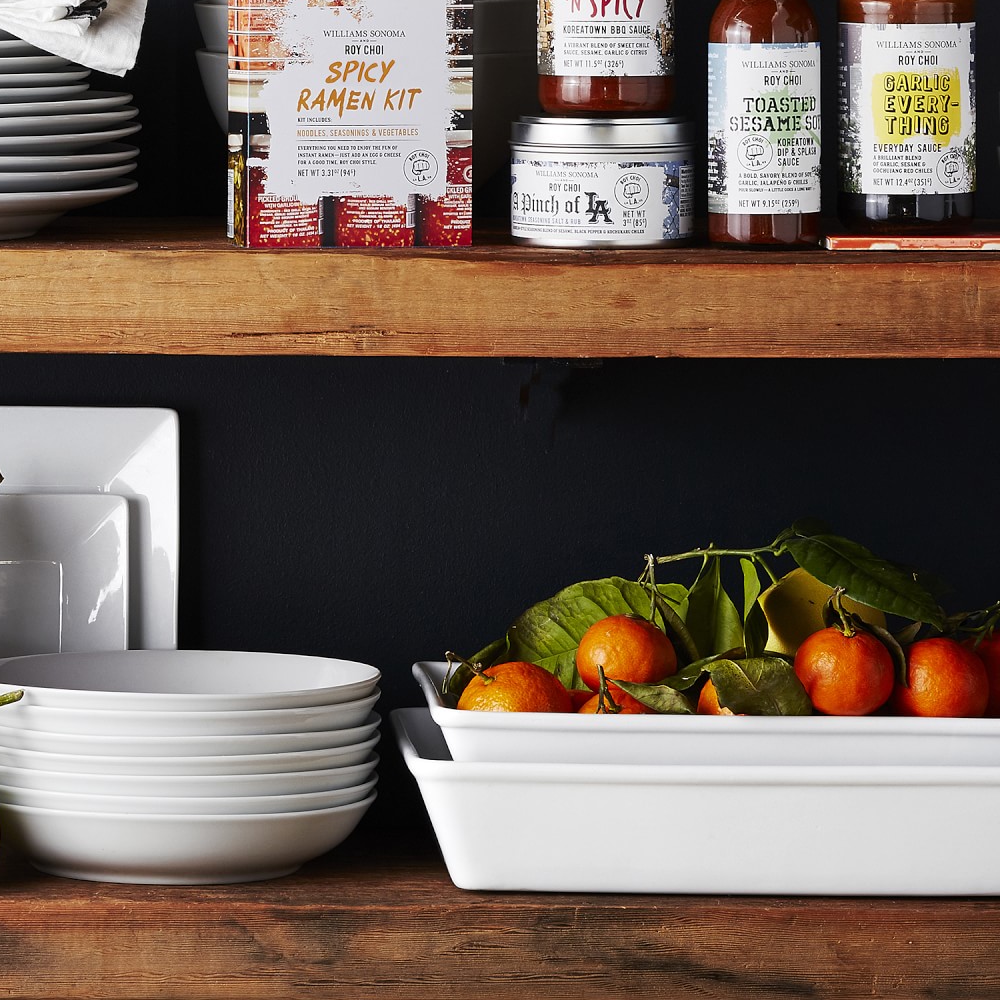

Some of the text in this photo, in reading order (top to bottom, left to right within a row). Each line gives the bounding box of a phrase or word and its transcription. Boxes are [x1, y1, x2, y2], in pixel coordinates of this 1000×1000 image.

[323, 30, 406, 38] WILLIAMS SONOMA
[563, 25, 651, 34] KOREATOWN BBQ SAUCE
[876, 40, 958, 49] WILLIAMS SONOMA
[344, 44, 384, 55] ROY CHOI
[564, 60, 573, 68] NET
[574, 60, 583, 68] WT
[742, 60, 816, 68] WILLIAMS SONOMA
[898, 55, 938, 66] ROY CHOI
[325, 59, 396, 84] SPICY
[764, 76, 802, 86] ROY CHOI
[884, 74, 950, 92] GARLIC
[297, 87, 422, 120] RAMEN KIT
[742, 96, 816, 112] TOASTED
[884, 95, 959, 114] EVERY-
[730, 116, 802, 132] SESAME
[884, 115, 950, 136] THING
[378, 128, 419, 136] VEGETABLES
[777, 138, 814, 146] KOREATOWN
[777, 147, 817, 156] DIP & SPLASH
[873, 144, 942, 152] EVERYDAY SAUCE
[778, 158, 800, 166] SAUCE
[536, 170, 566, 178] WILLIAMS
[873, 178, 883, 186] NET
[884, 178, 894, 186] WT
[548, 182, 581, 192] ROY CHOI
[520, 192, 559, 217] Pinch
[565, 196, 580, 214] of
[584, 192, 614, 224] LA
[738, 200, 748, 208] NET
[750, 200, 760, 208] WT
[622, 210, 646, 218] NET WT
